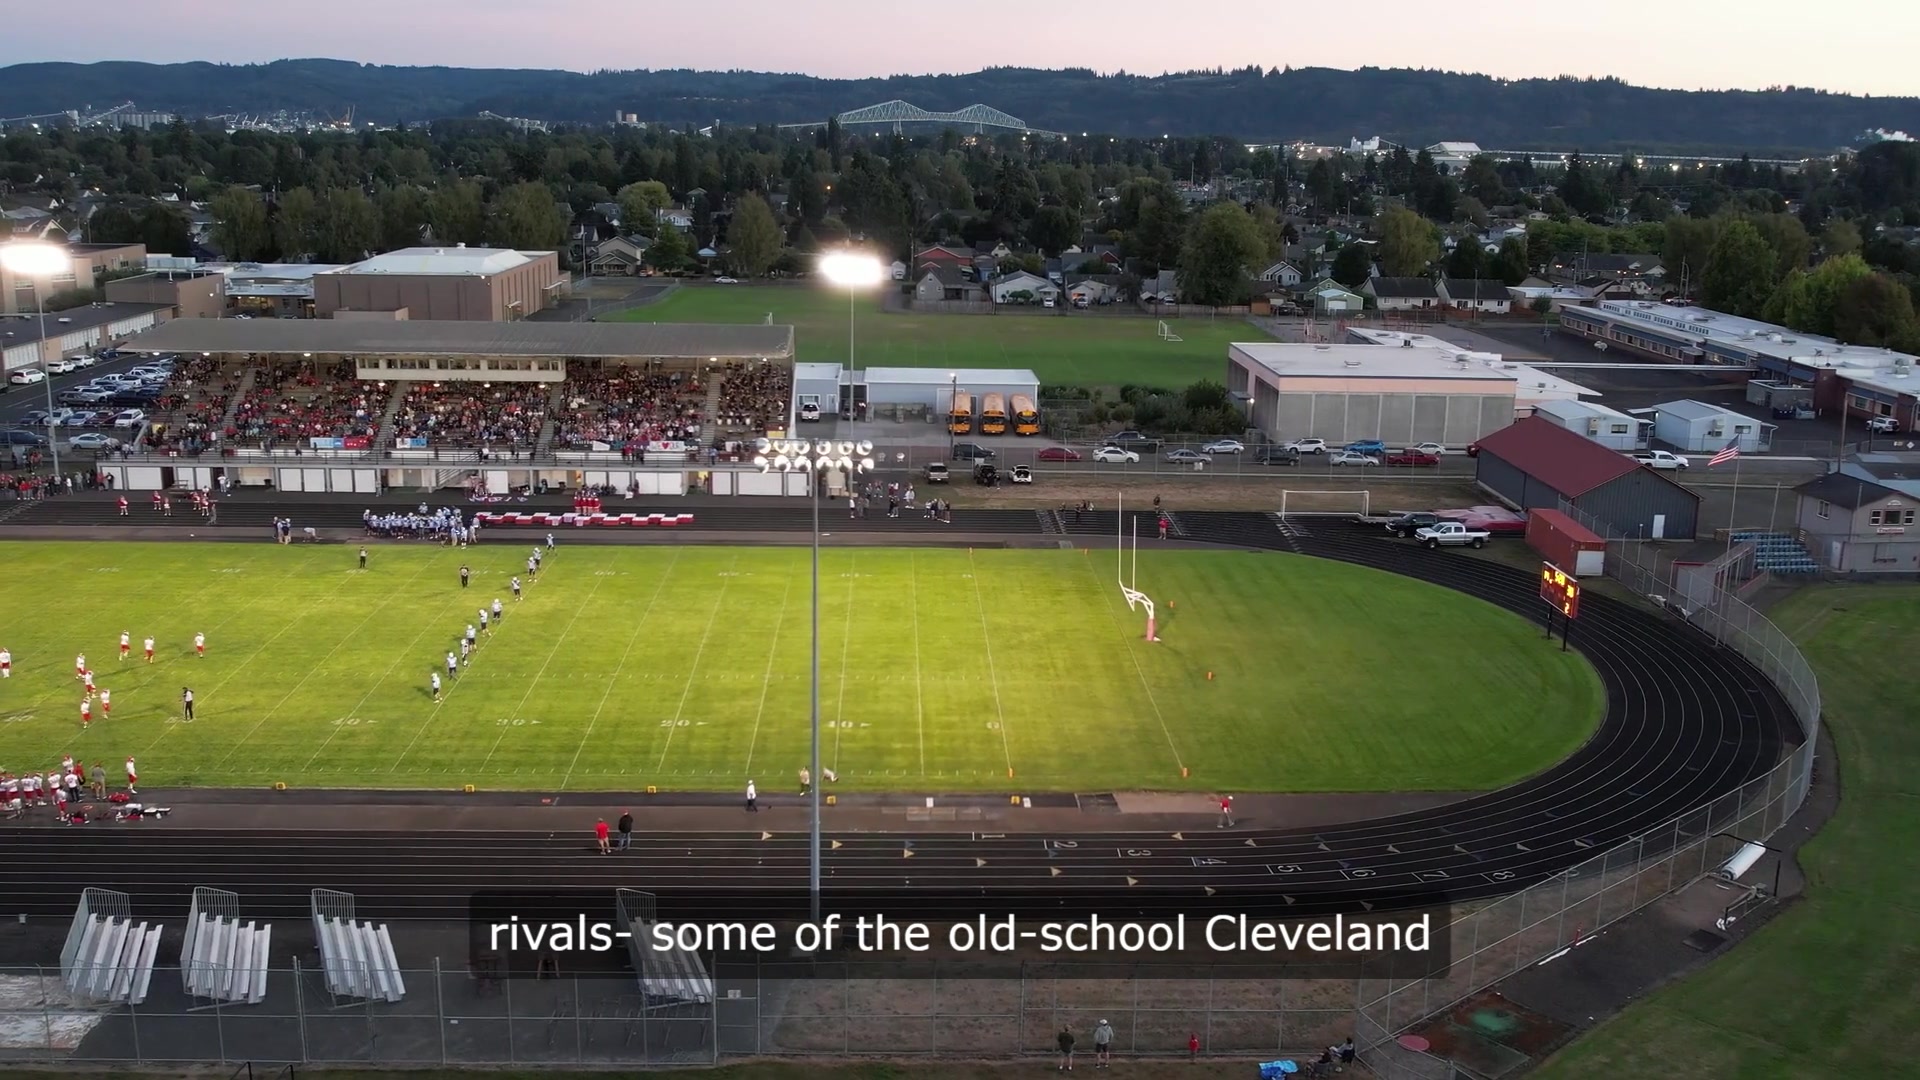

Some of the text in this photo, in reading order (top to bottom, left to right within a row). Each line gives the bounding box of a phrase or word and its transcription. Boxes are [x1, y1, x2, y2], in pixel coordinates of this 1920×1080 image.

[660, 719, 690, 727] 20
[1053, 840, 1078, 849] 2
[1127, 849, 1152, 857] 3
[1202, 858, 1227, 866] 4
[1277, 864, 1303, 873] 5
[1352, 869, 1377, 879] 6
[1423, 870, 1451, 879] 7
[1492, 870, 1516, 881] 8
